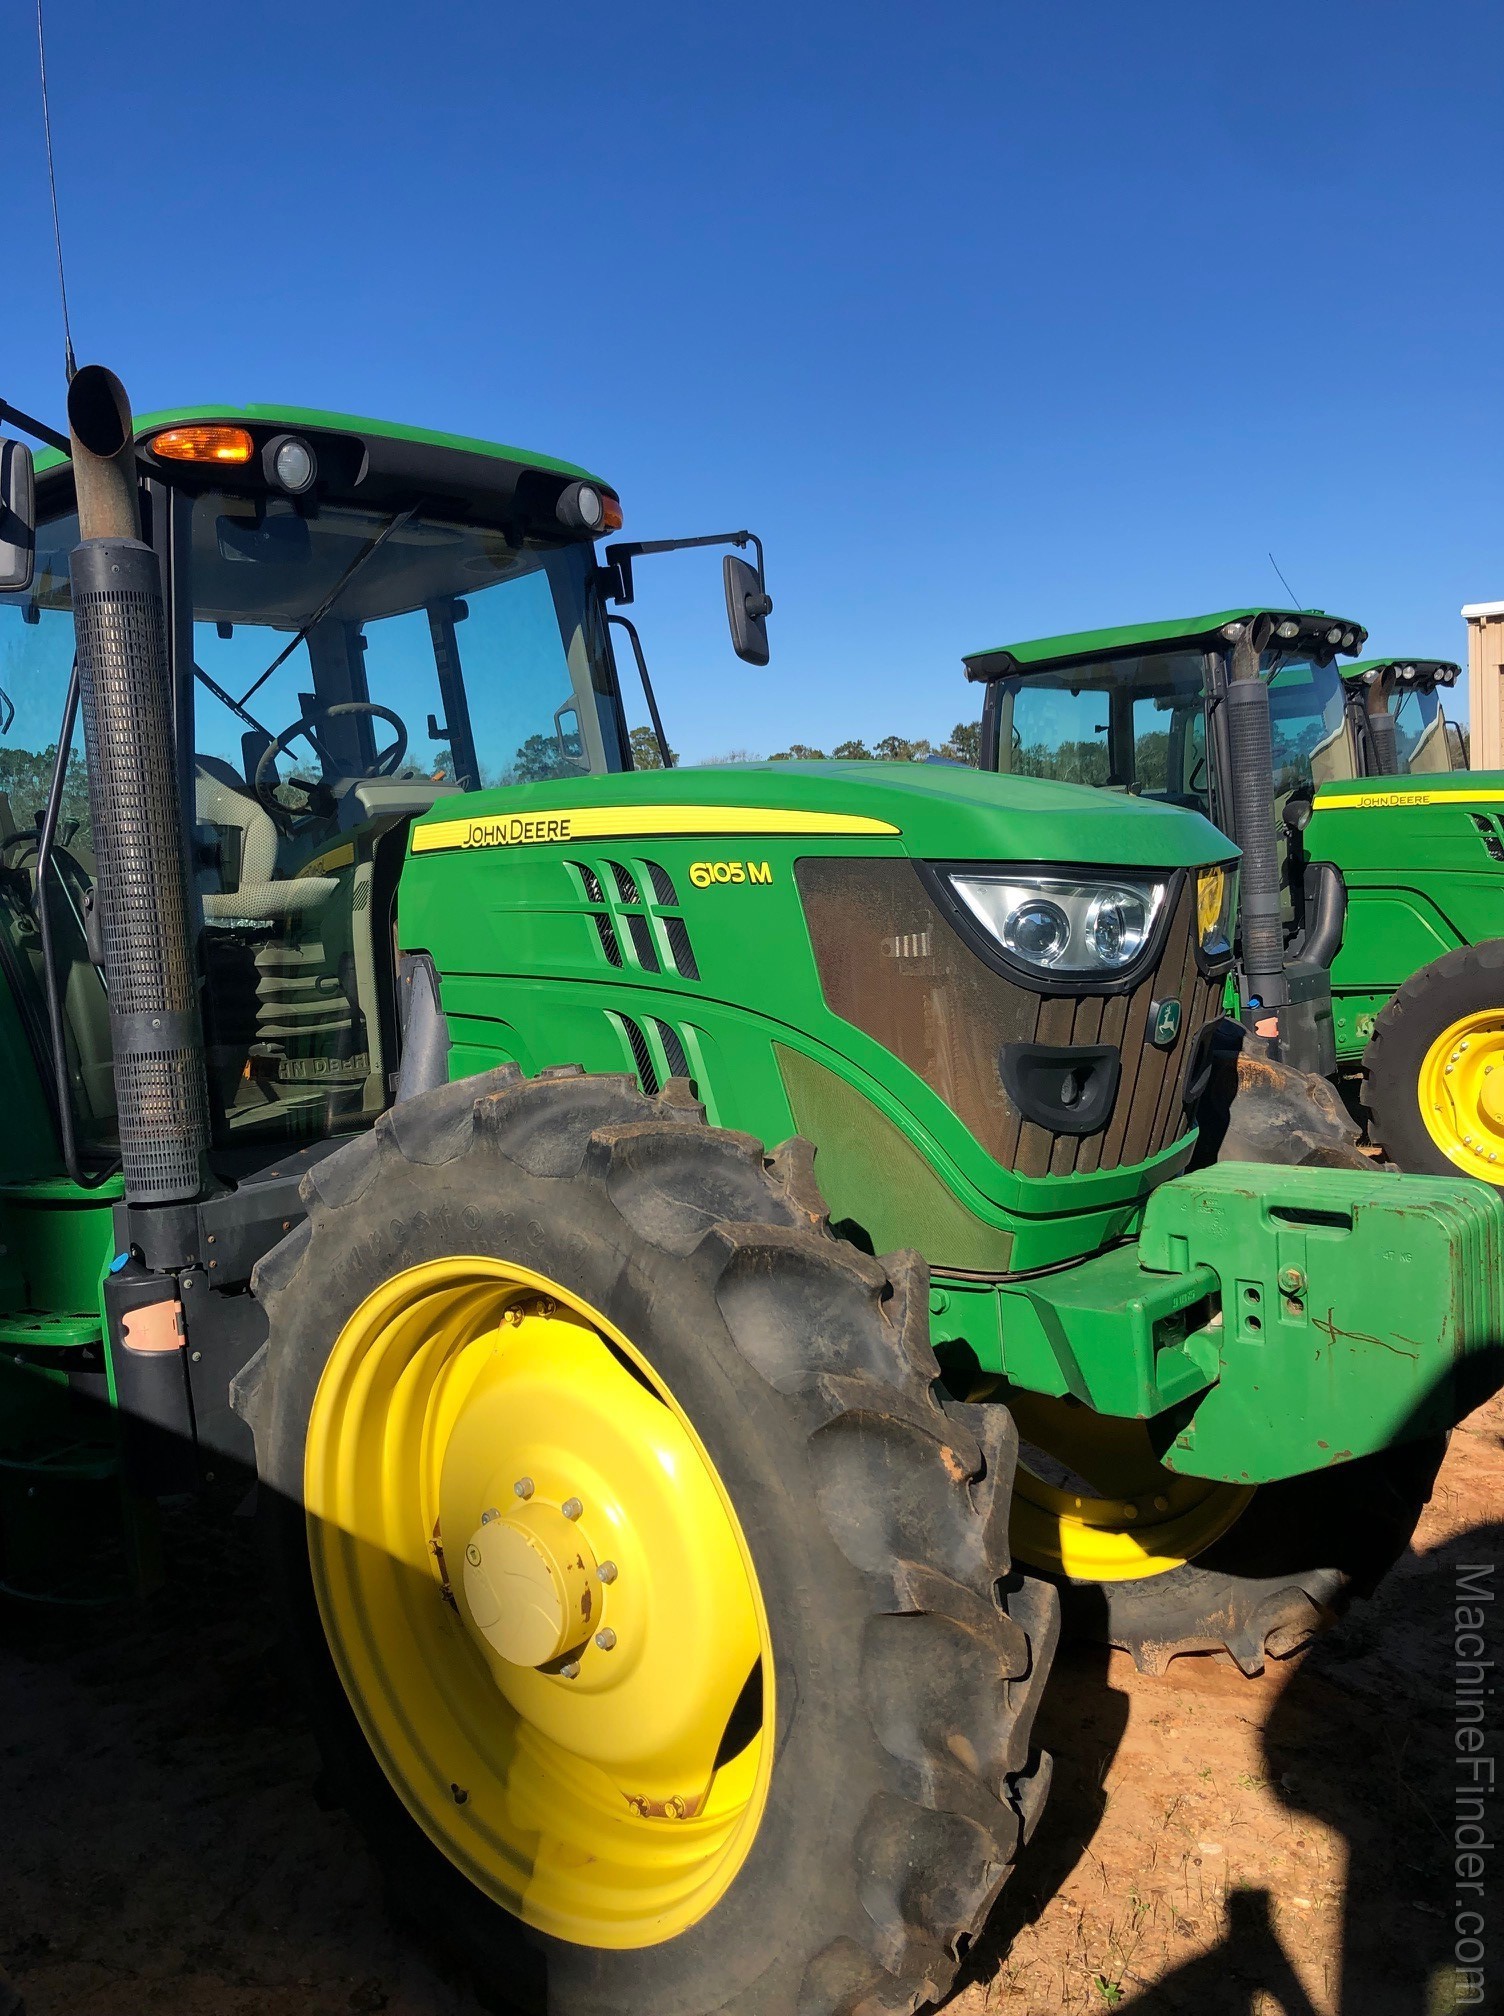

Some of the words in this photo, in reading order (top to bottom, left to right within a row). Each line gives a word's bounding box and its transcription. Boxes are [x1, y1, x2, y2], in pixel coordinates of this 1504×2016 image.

[1359, 797, 1388, 807] JOHN
[1390, 795, 1430, 805] DEERE
[463, 823, 507, 844] JOHN
[511, 819, 571, 840] DEERE
[690, 861, 746, 889] 6105
[747, 861, 773, 885] M
